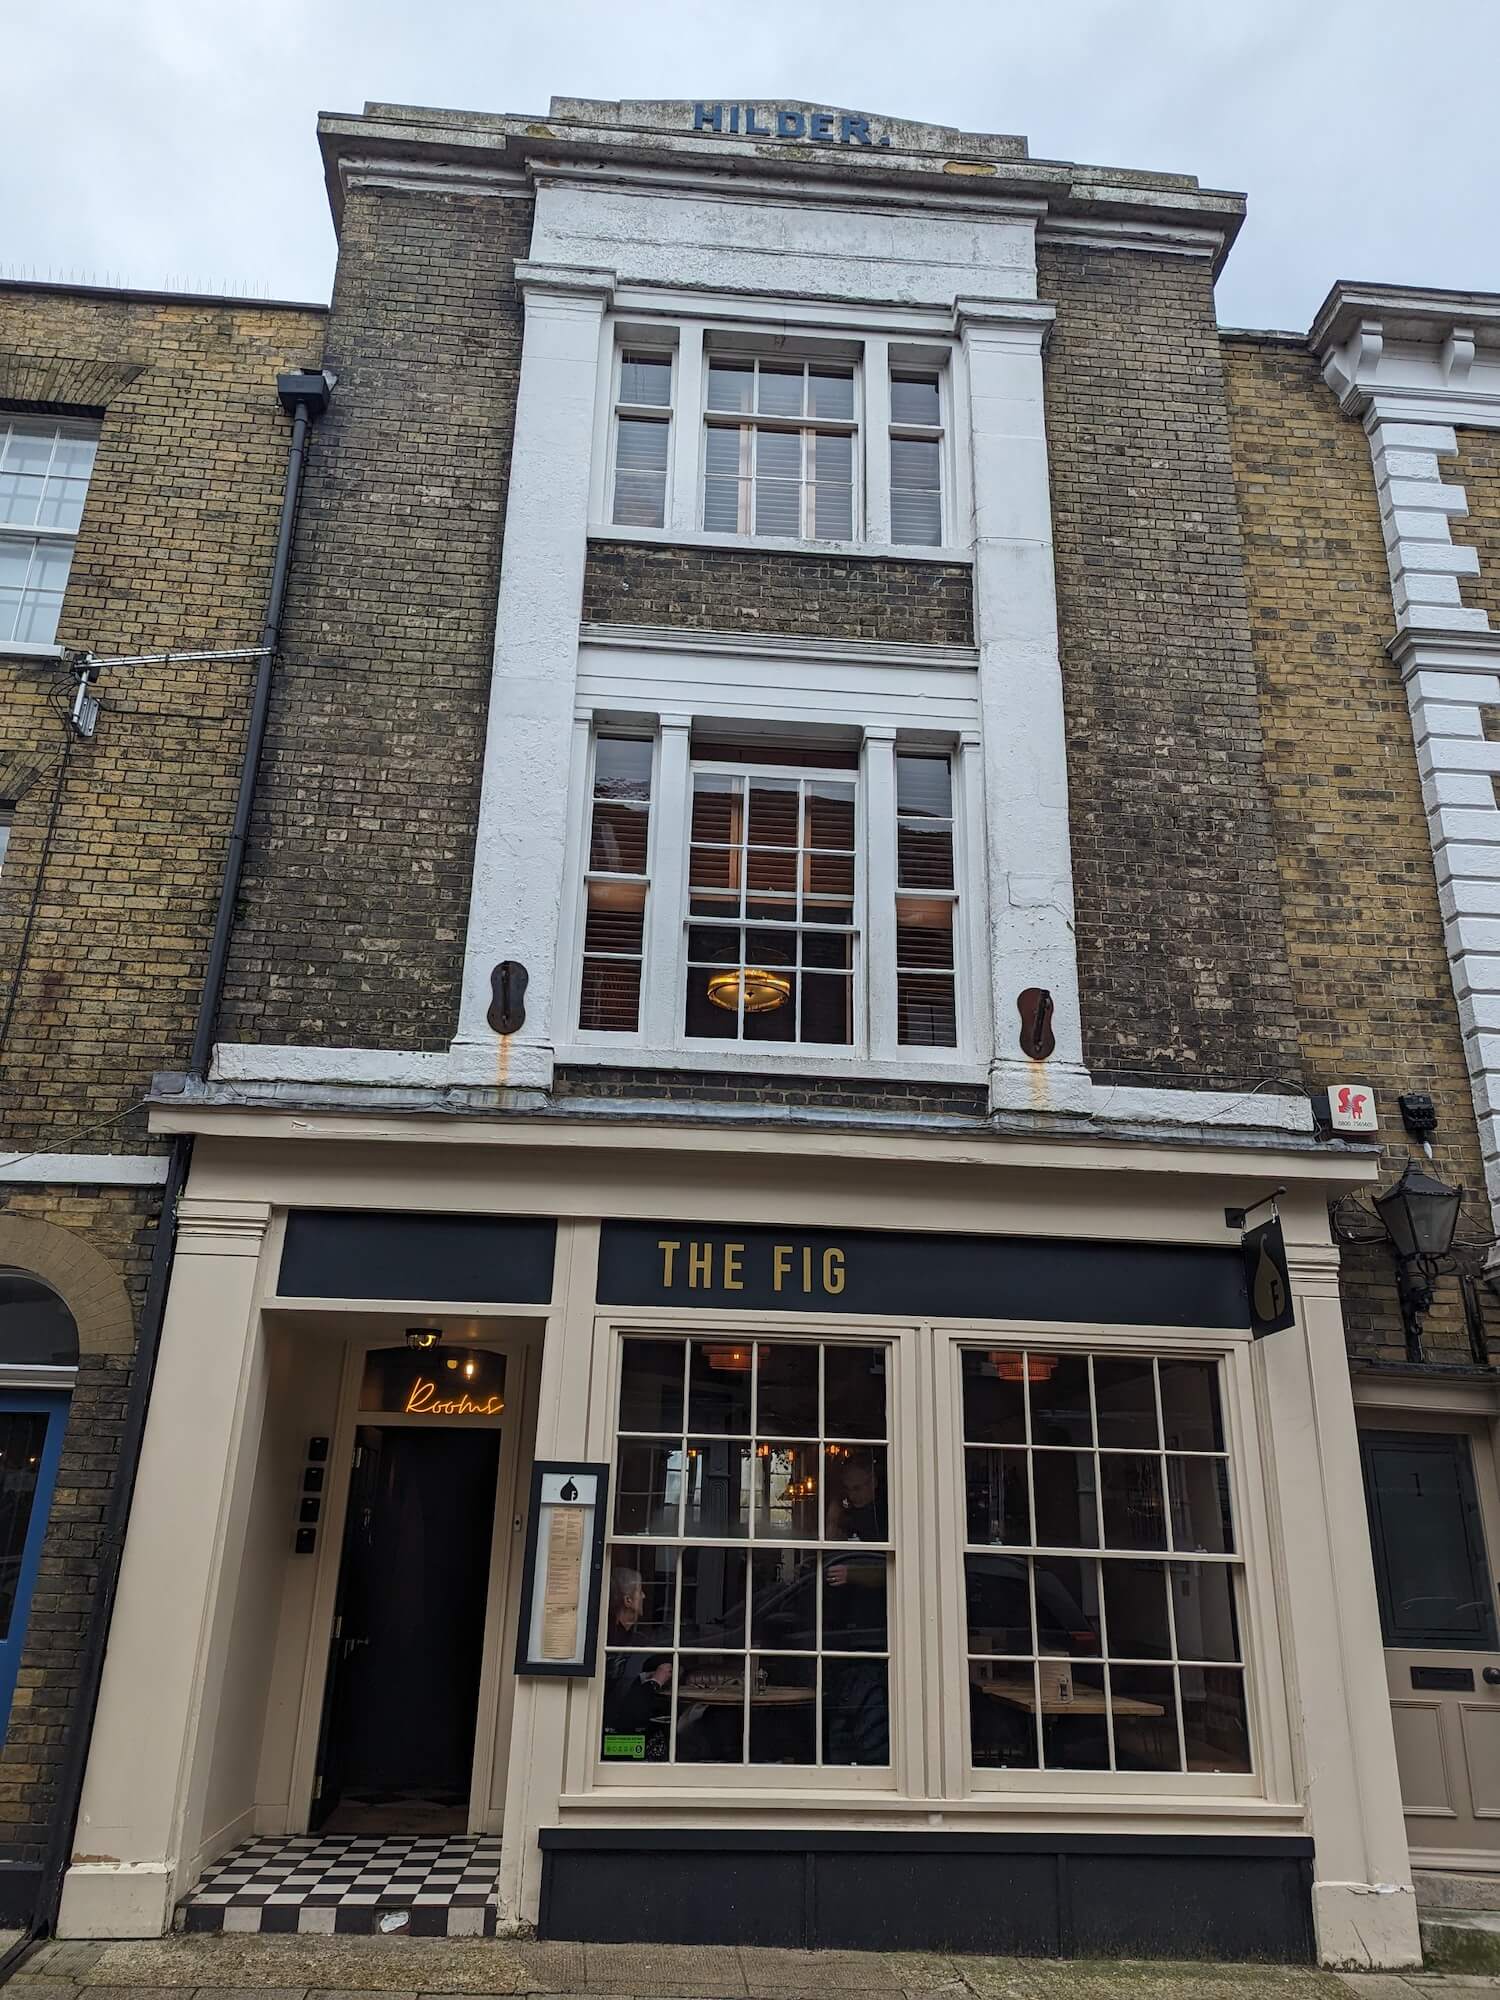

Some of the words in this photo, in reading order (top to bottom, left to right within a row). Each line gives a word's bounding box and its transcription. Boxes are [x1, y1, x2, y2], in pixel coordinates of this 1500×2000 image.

[693, 103, 890, 146] HILDER.
[658, 1241, 745, 1289] THE
[773, 1245, 845, 1294] FIG
[405, 1377, 504, 1414] Rooms
